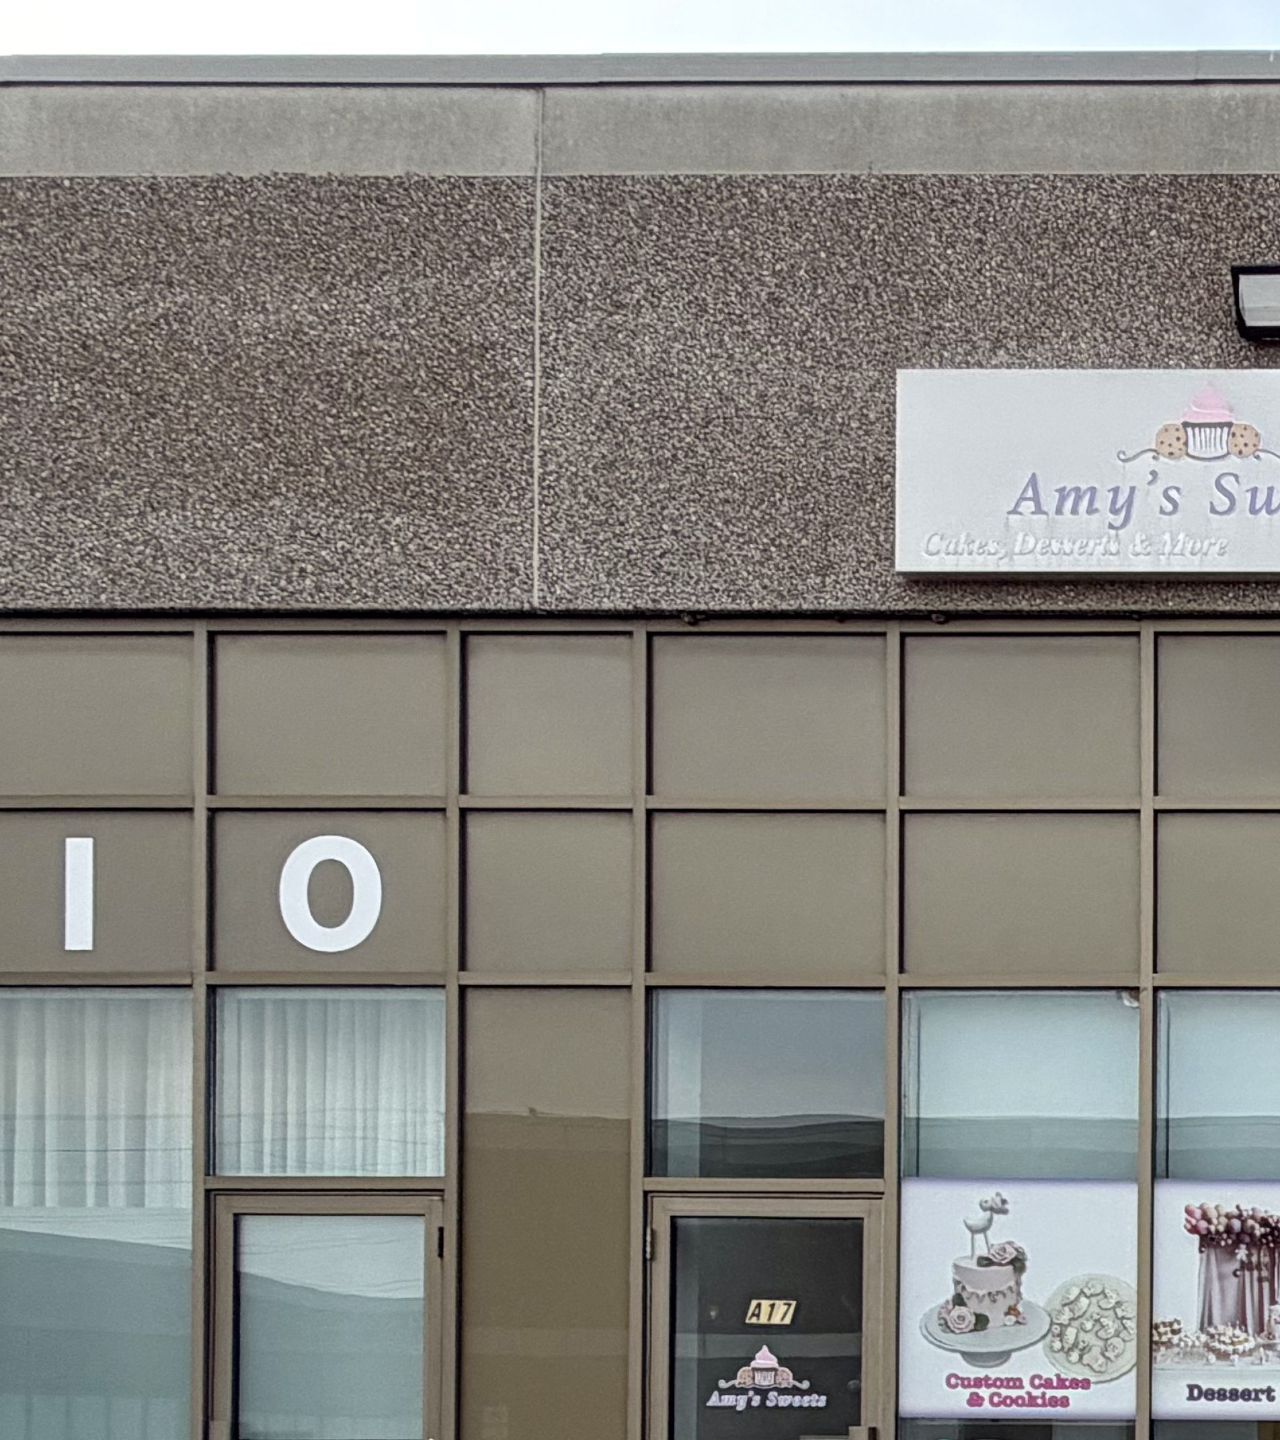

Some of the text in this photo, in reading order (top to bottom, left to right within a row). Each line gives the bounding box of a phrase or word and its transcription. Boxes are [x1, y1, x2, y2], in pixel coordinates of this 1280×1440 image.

[1008, 470, 1183, 530] Amy's
[920, 532, 1009, 561] Cakes,
[1013, 532, 1121, 557] Desserts
[1129, 532, 1151, 557] &
[1151, 532, 1229, 557] More
[747, 1301, 793, 1323] A17
[945, 1372, 1092, 1391] Custom Cakes
[706, 1390, 827, 1412] Amy's Sweets
[967, 1391, 1070, 1409] & Cookies
[1186, 1383, 1276, 1403] Dessert
